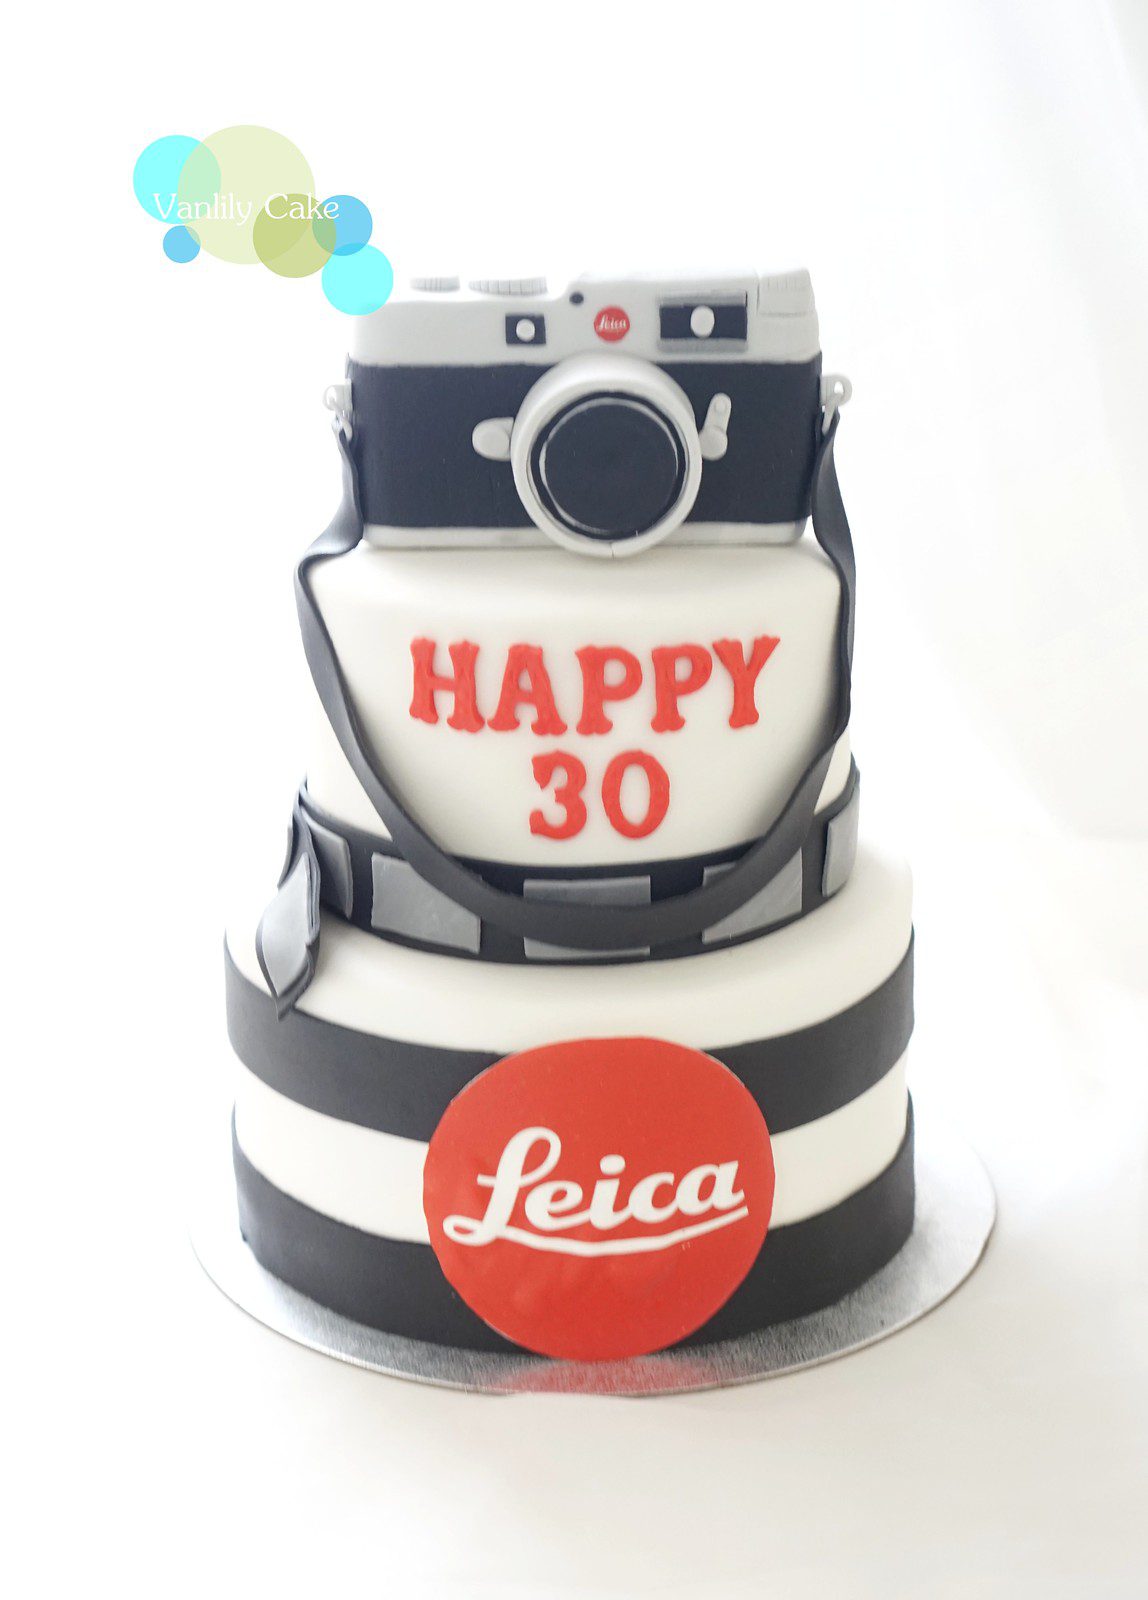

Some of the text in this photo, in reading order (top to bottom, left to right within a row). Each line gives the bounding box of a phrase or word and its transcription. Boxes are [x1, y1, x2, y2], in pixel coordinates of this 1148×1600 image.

[409, 635, 780, 737] HAPPY
[529, 749, 671, 841] 30
[442, 1125, 749, 1257] Leica
